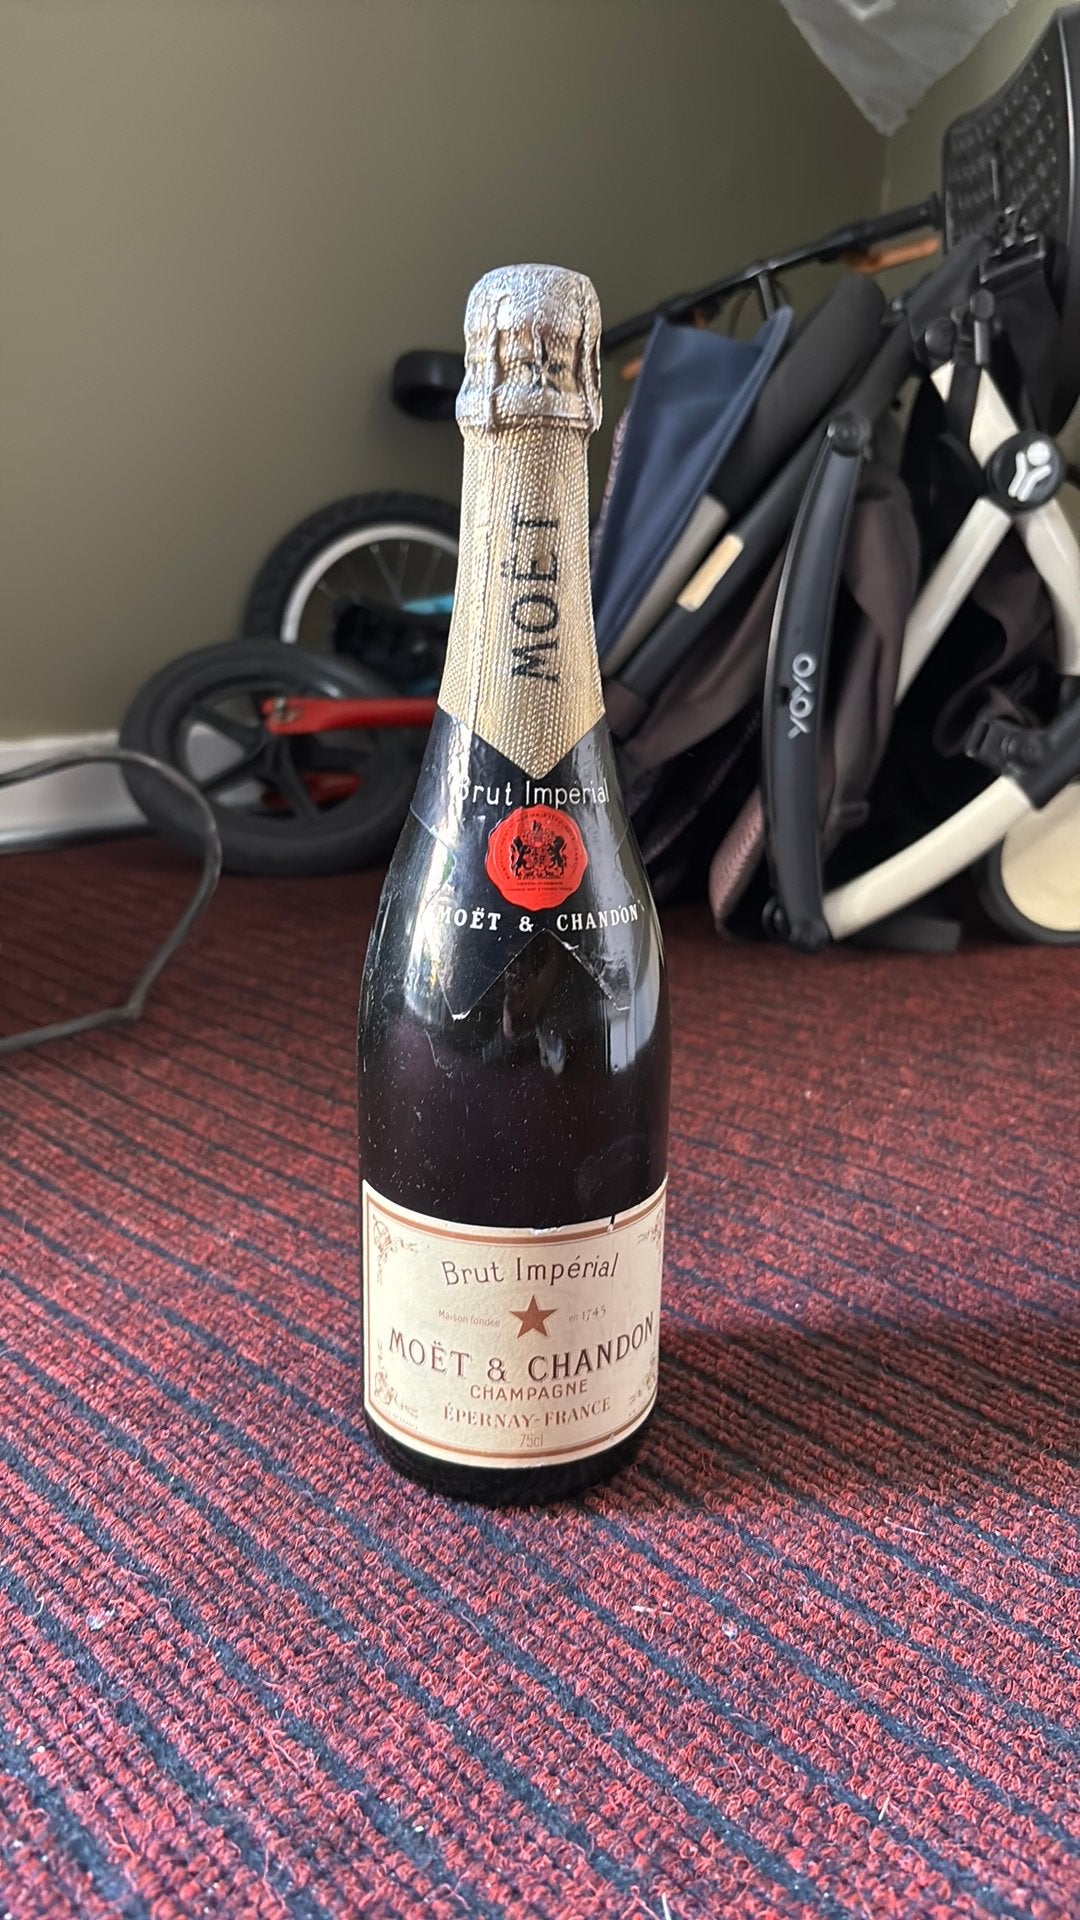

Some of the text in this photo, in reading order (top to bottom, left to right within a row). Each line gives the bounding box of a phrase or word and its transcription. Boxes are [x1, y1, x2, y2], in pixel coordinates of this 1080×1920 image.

[501, 505, 560, 683] MOËT
[788, 653, 817, 739] YOYO
[458, 776, 513, 807] Brut
[440, 903, 639, 933] MOËT & CHANDON
[441, 1252, 620, 1286] Brut Impérial
[438, 1309, 469, 1325] Maison
[389, 1311, 655, 1383] MOËT & CHANDON
[470, 1379, 588, 1401] CHAMPAGNE
[520, 1432, 544, 1448] 75cl
